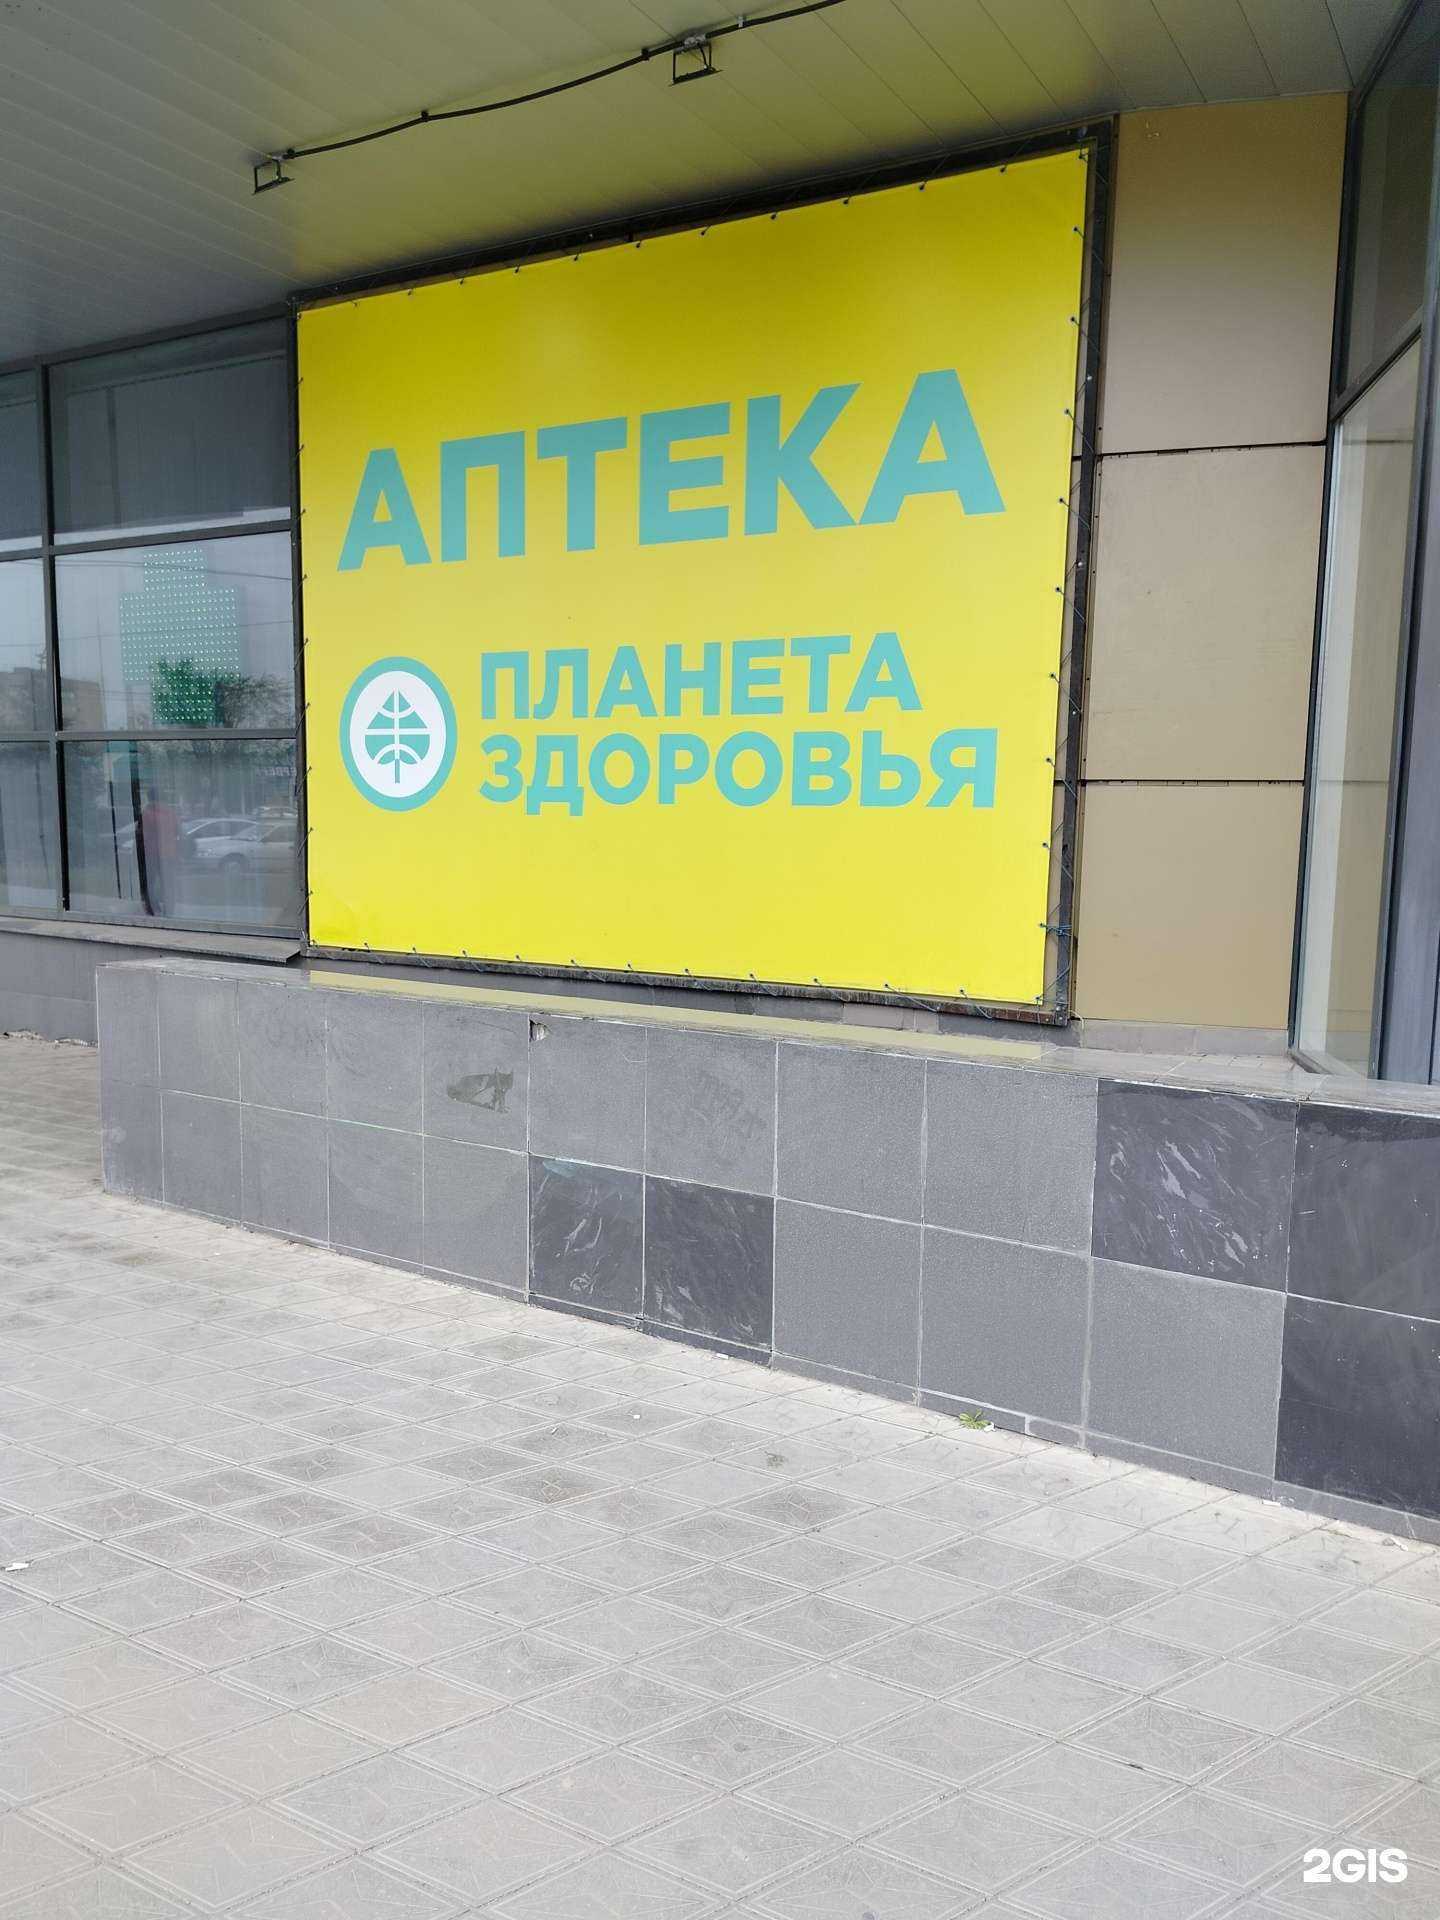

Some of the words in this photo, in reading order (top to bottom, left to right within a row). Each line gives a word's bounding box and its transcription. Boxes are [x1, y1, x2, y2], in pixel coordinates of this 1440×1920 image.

[337, 369, 1005, 571] АПТЕКА
[480, 632, 923, 721] ПЛАНЕТА
[479, 728, 999, 817] ЗДОРОВЬЯ
